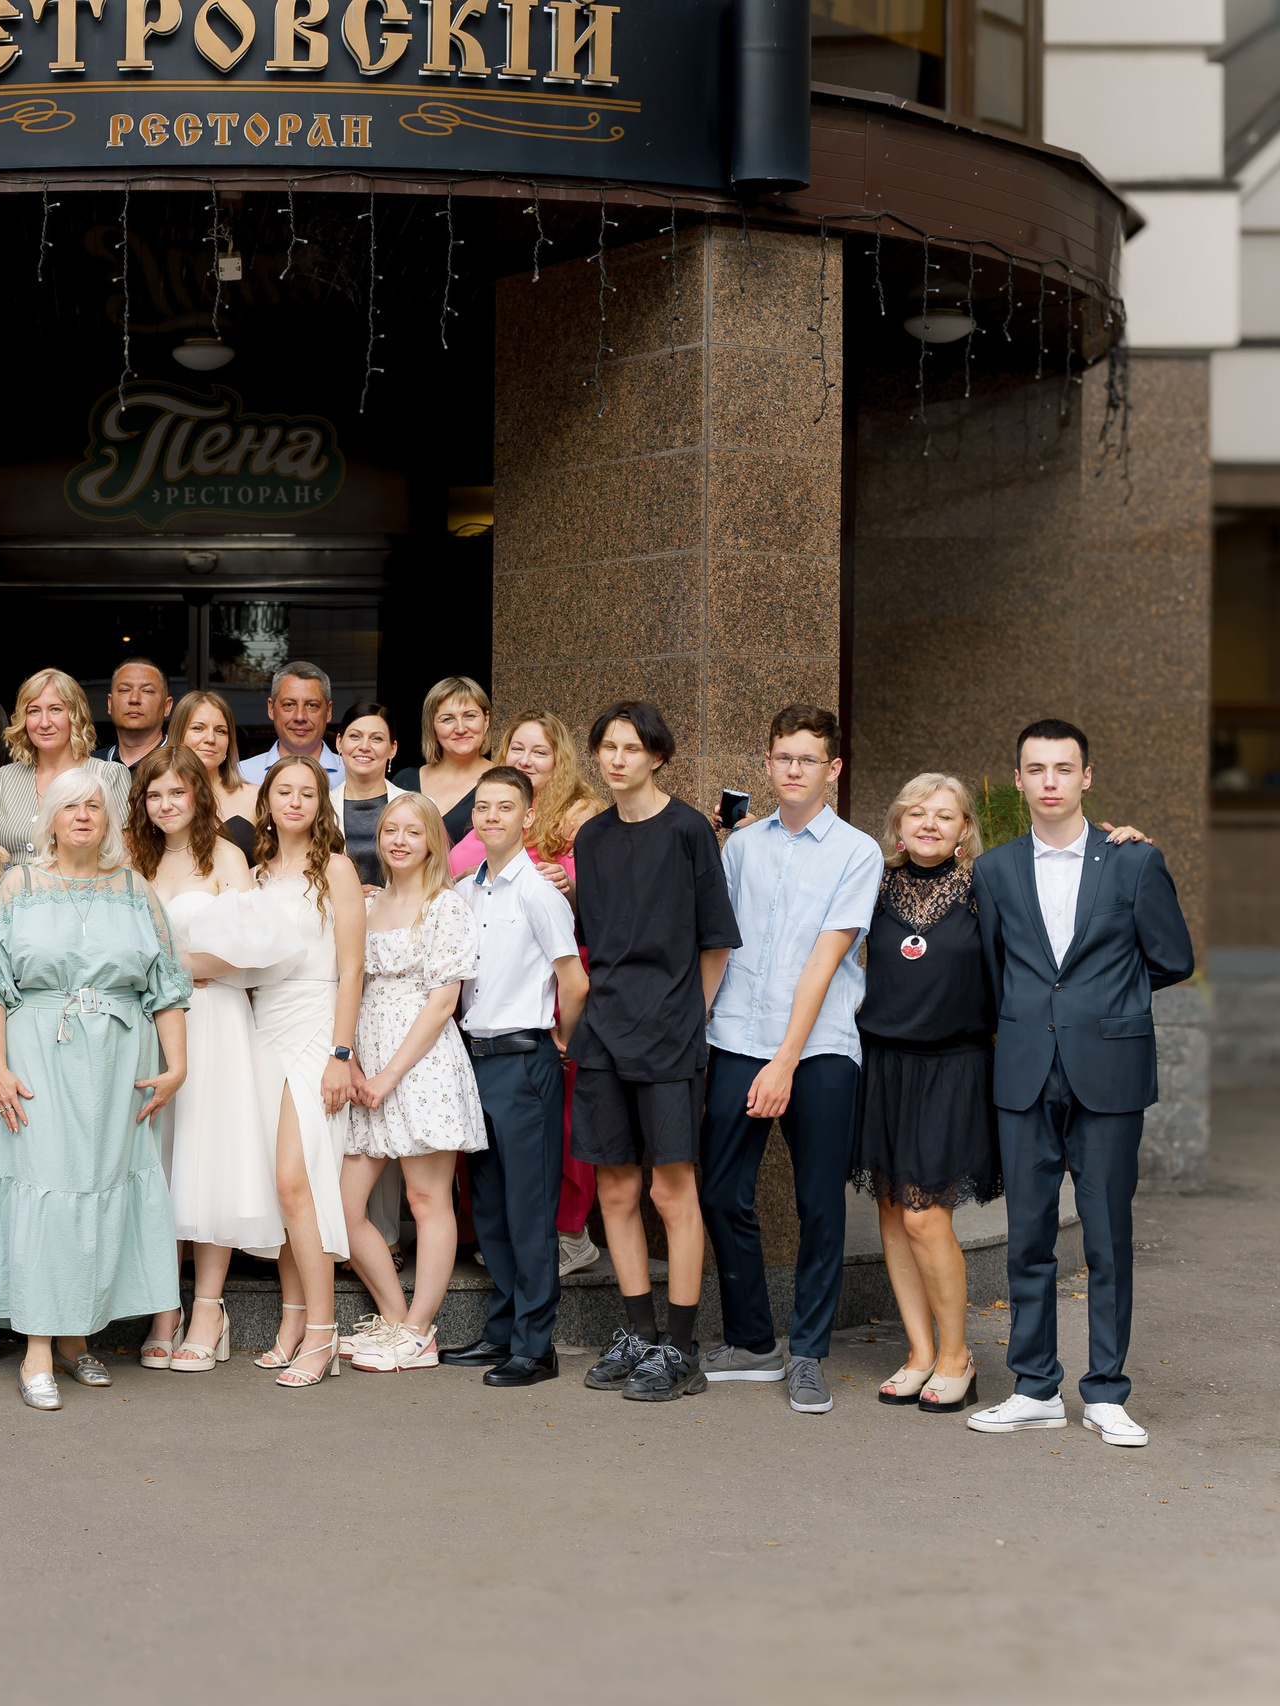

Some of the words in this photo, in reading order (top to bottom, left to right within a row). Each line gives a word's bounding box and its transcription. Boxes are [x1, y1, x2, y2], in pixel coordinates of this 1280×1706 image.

[106, 112, 372, 148] РЕСТОРАН
[77, 394, 328, 506] Пена
[164, 484, 311, 506] РЕСТОРАН
